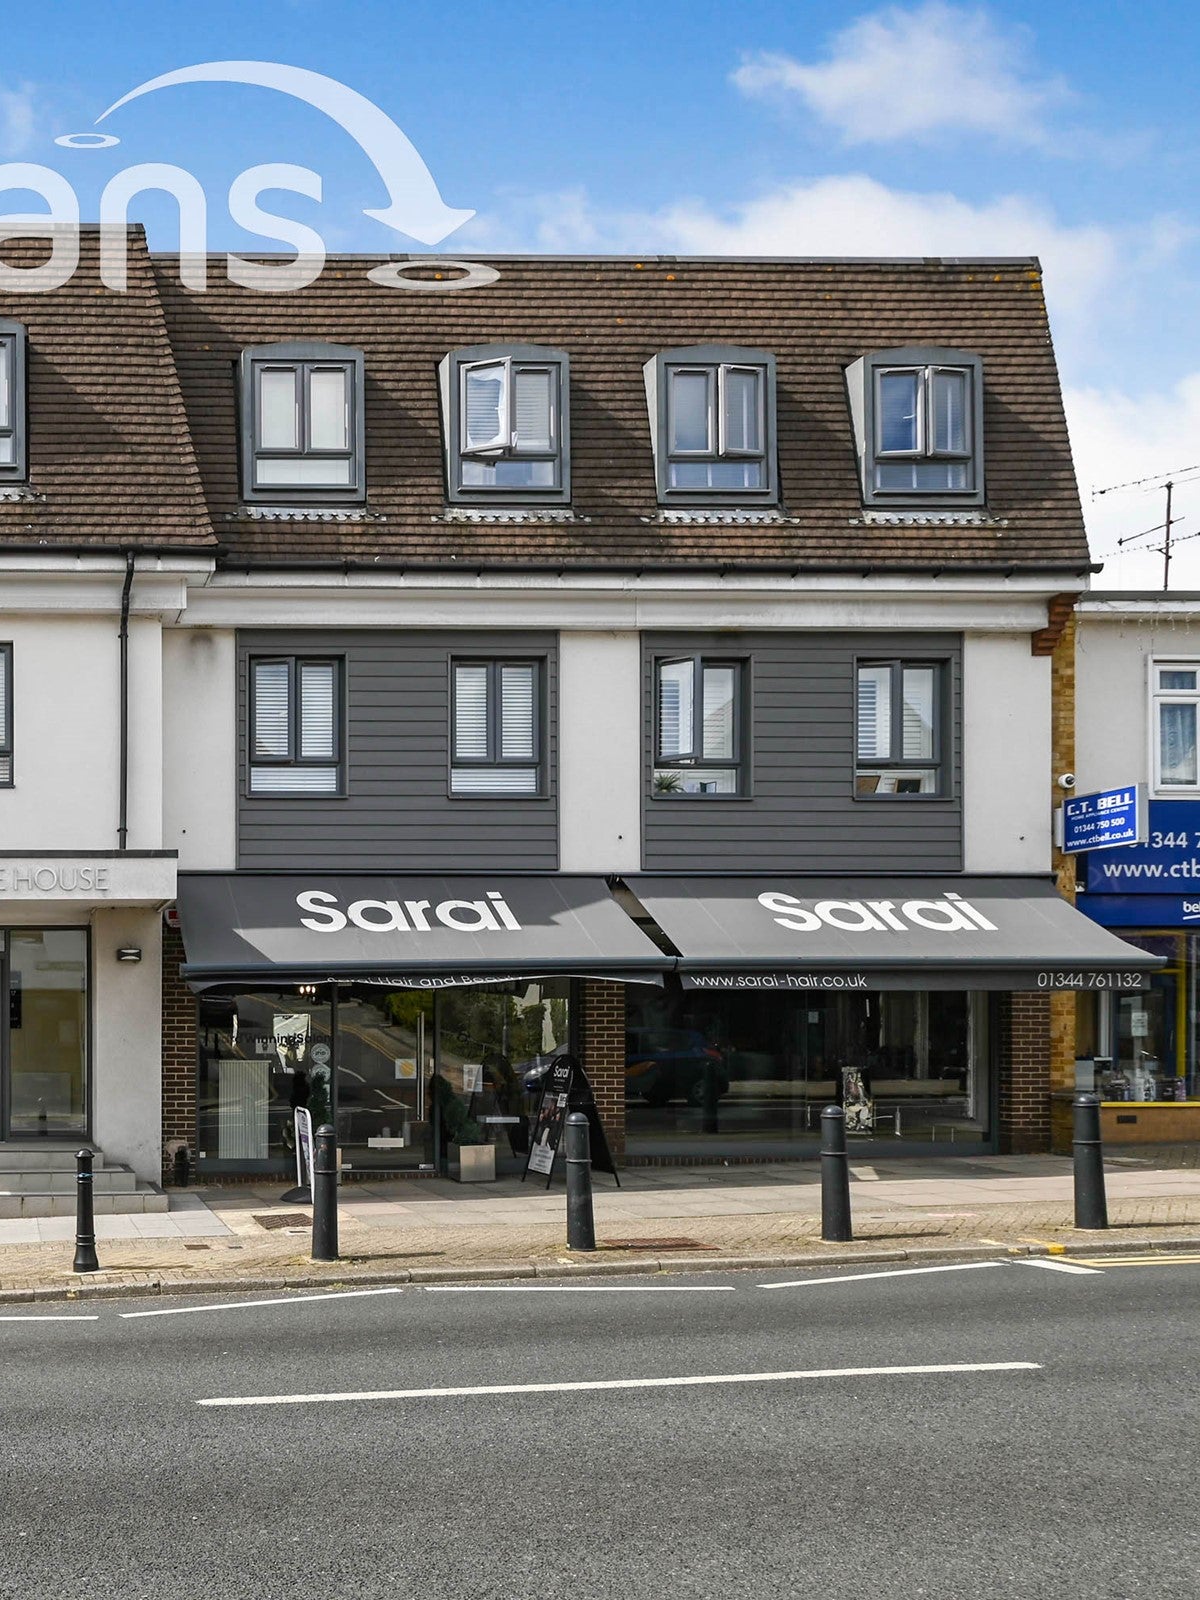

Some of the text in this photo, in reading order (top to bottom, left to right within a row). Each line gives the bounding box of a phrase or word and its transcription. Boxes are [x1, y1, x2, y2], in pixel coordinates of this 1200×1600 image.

[1067, 792, 1134, 816] C.T. BELL
[1074, 816, 1125, 833] 01344 750 500
[1066, 828, 1134, 847] www.ctbell.co.uk
[1128, 831, 1188, 848] 344
[13, 868, 109, 892] HOUSE
[296, 890, 522, 933] Sarai
[757, 891, 999, 932] Sarai
[419, 975, 456, 987] and
[690, 973, 868, 988] www.sarai-hair.co.uk
[1037, 972, 1142, 987] 01344 761132
[553, 1065, 570, 1078] Sarai
